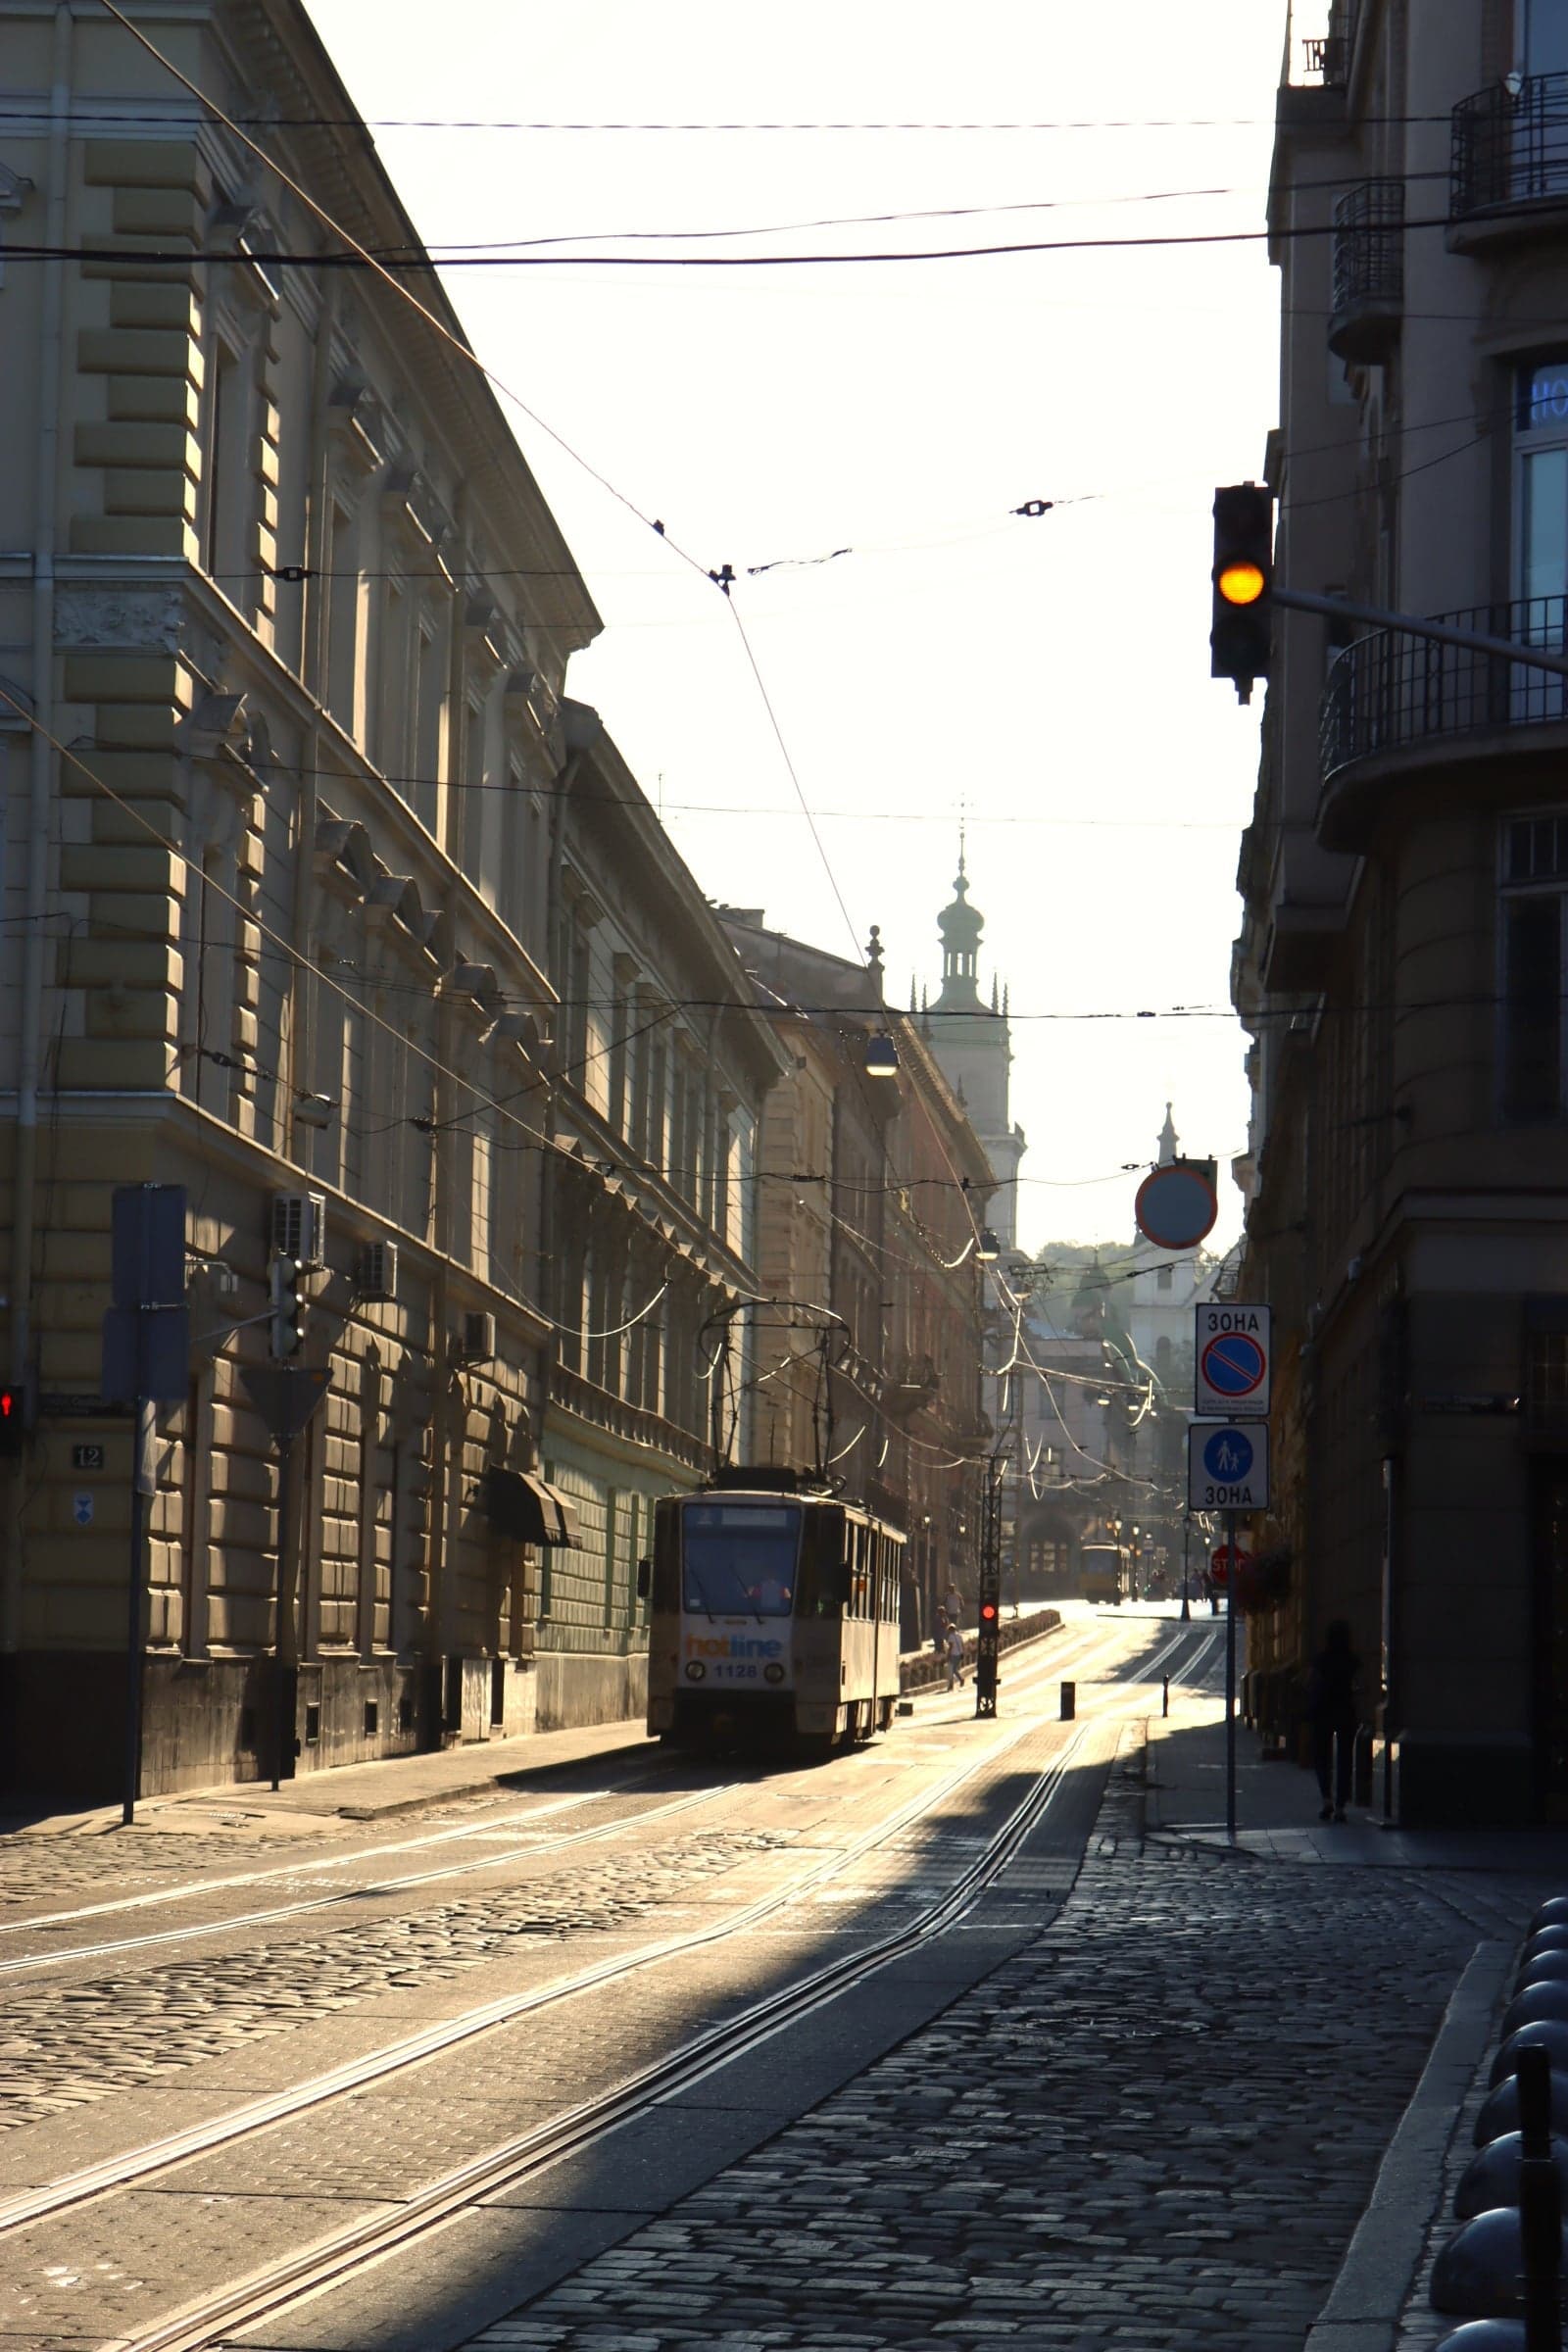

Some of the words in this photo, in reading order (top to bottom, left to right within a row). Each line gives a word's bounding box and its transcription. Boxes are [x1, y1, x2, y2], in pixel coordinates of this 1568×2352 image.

[1207, 1313, 1259, 1332] ЗОНА
[77, 1447, 100, 1466] 12
[1205, 1486, 1252, 1505] ЗОНА
[684, 1633, 783, 1658] hotline
[713, 1664, 758, 1679] 1128
